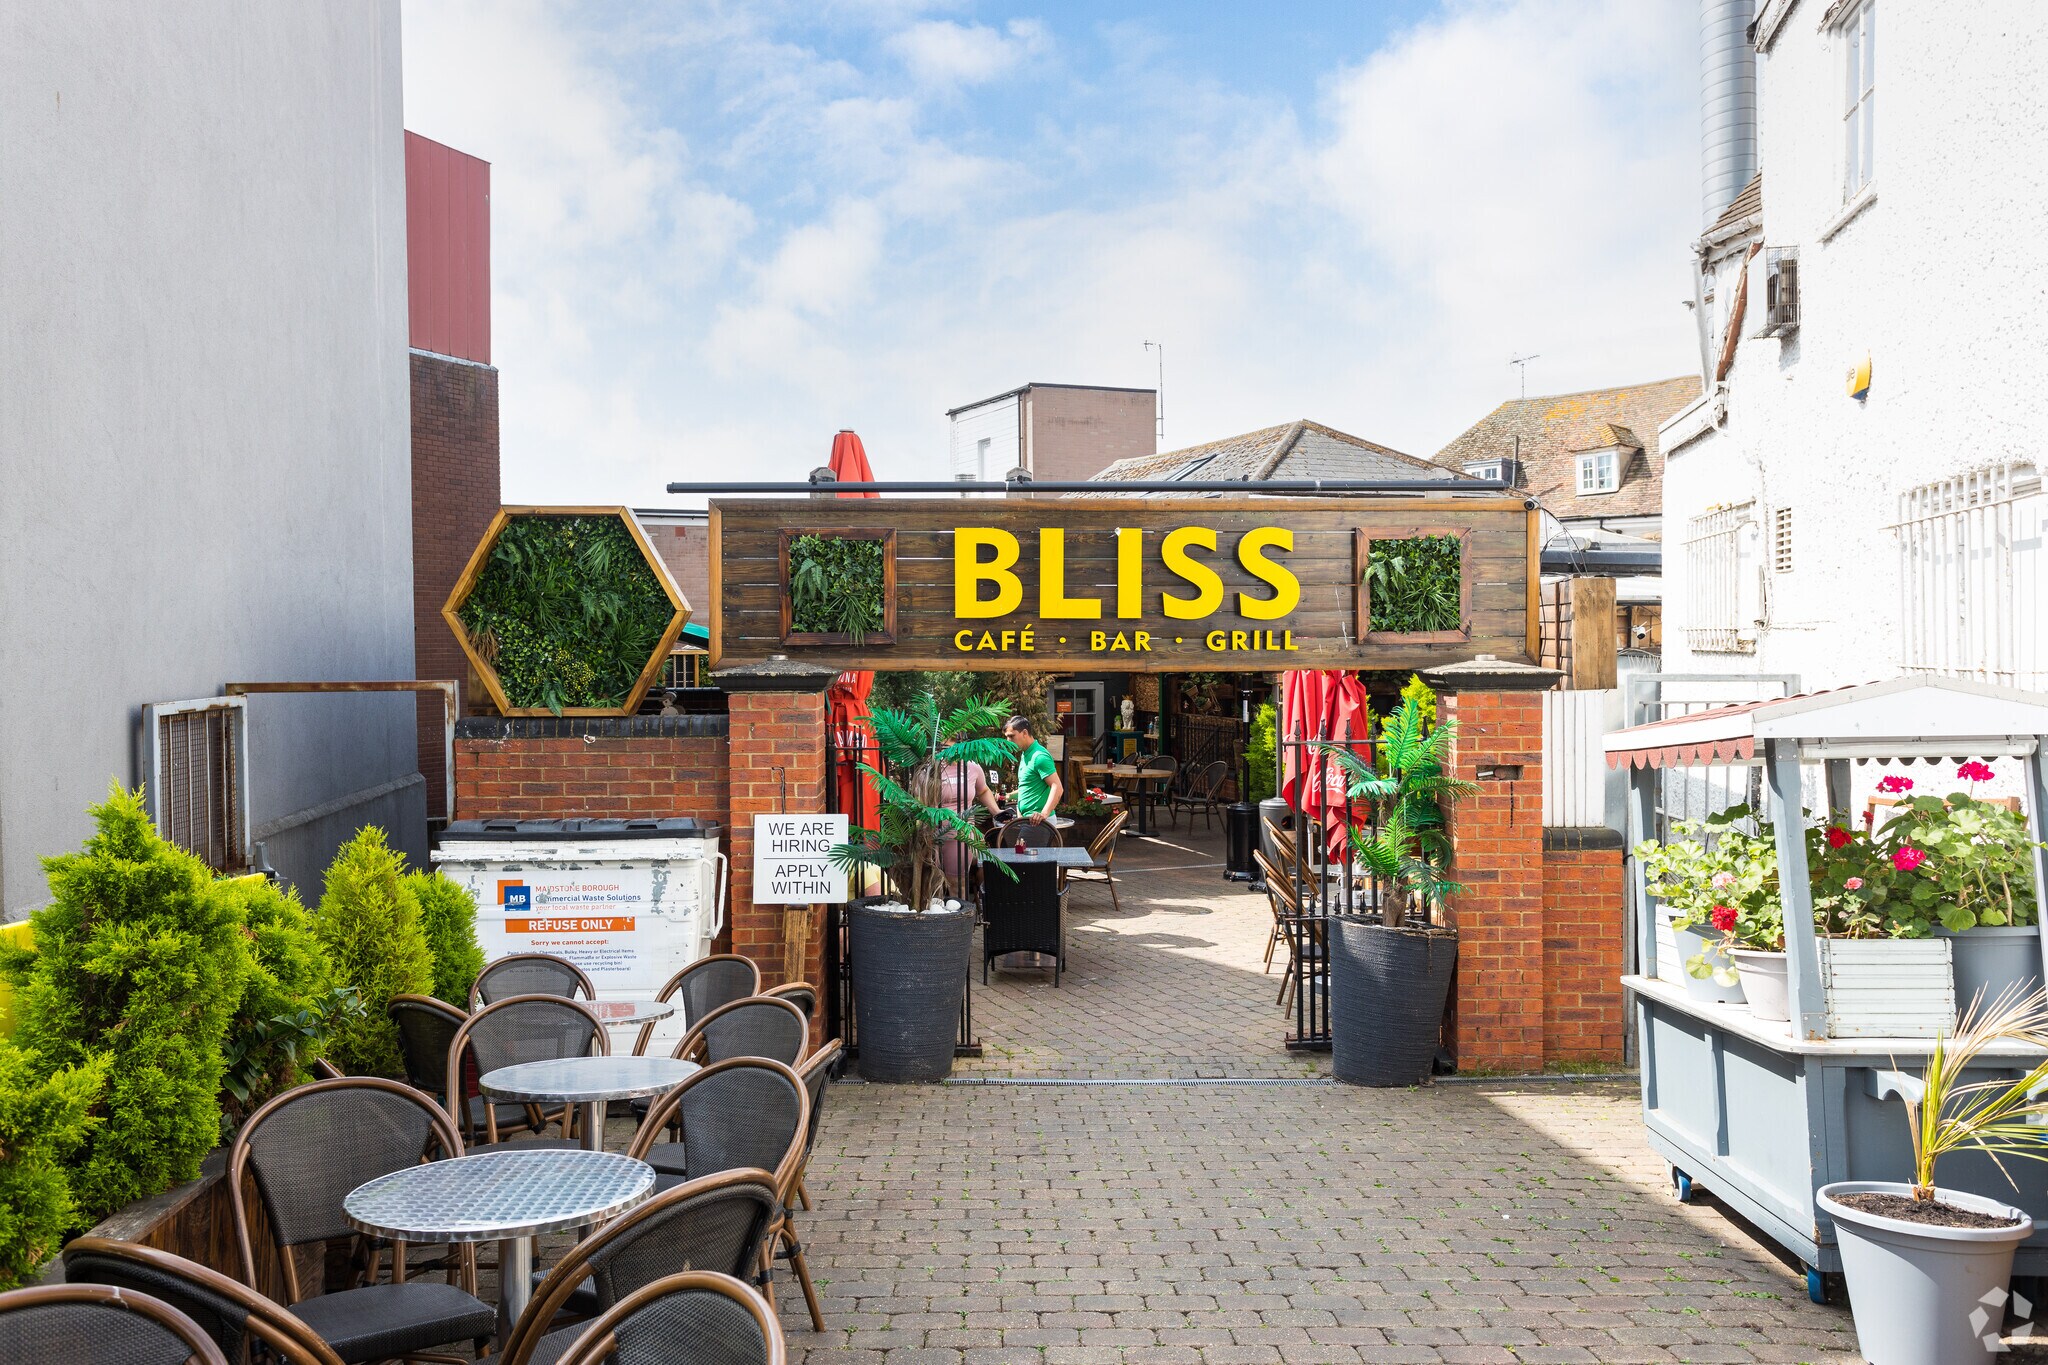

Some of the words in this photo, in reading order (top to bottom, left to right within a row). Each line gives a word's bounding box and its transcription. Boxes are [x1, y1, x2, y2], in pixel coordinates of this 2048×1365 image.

[954, 526, 1301, 620] BLISS
[954, 623, 1035, 652] CAFÉ
[1090, 632, 1152, 652] BAR
[1205, 629, 1299, 652] GRILL
[768, 822, 795, 836] WE
[800, 822, 835, 836] ARE
[772, 839, 830, 853] HIRING
[775, 864, 828, 878] APPLY
[535, 885, 580, 893] MADSTONE
[582, 884, 620, 892] BOROUGH
[771, 881, 831, 895] WITHIN
[509, 894, 527, 903] MB
[582, 894, 605, 902] Waste
[606, 893, 641, 901] Solutions
[528, 919, 578, 931] REFUSE
[581, 919, 614, 930] ONLY
[531, 939, 549, 947] Sorry
[585, 938, 609, 946] accept:
